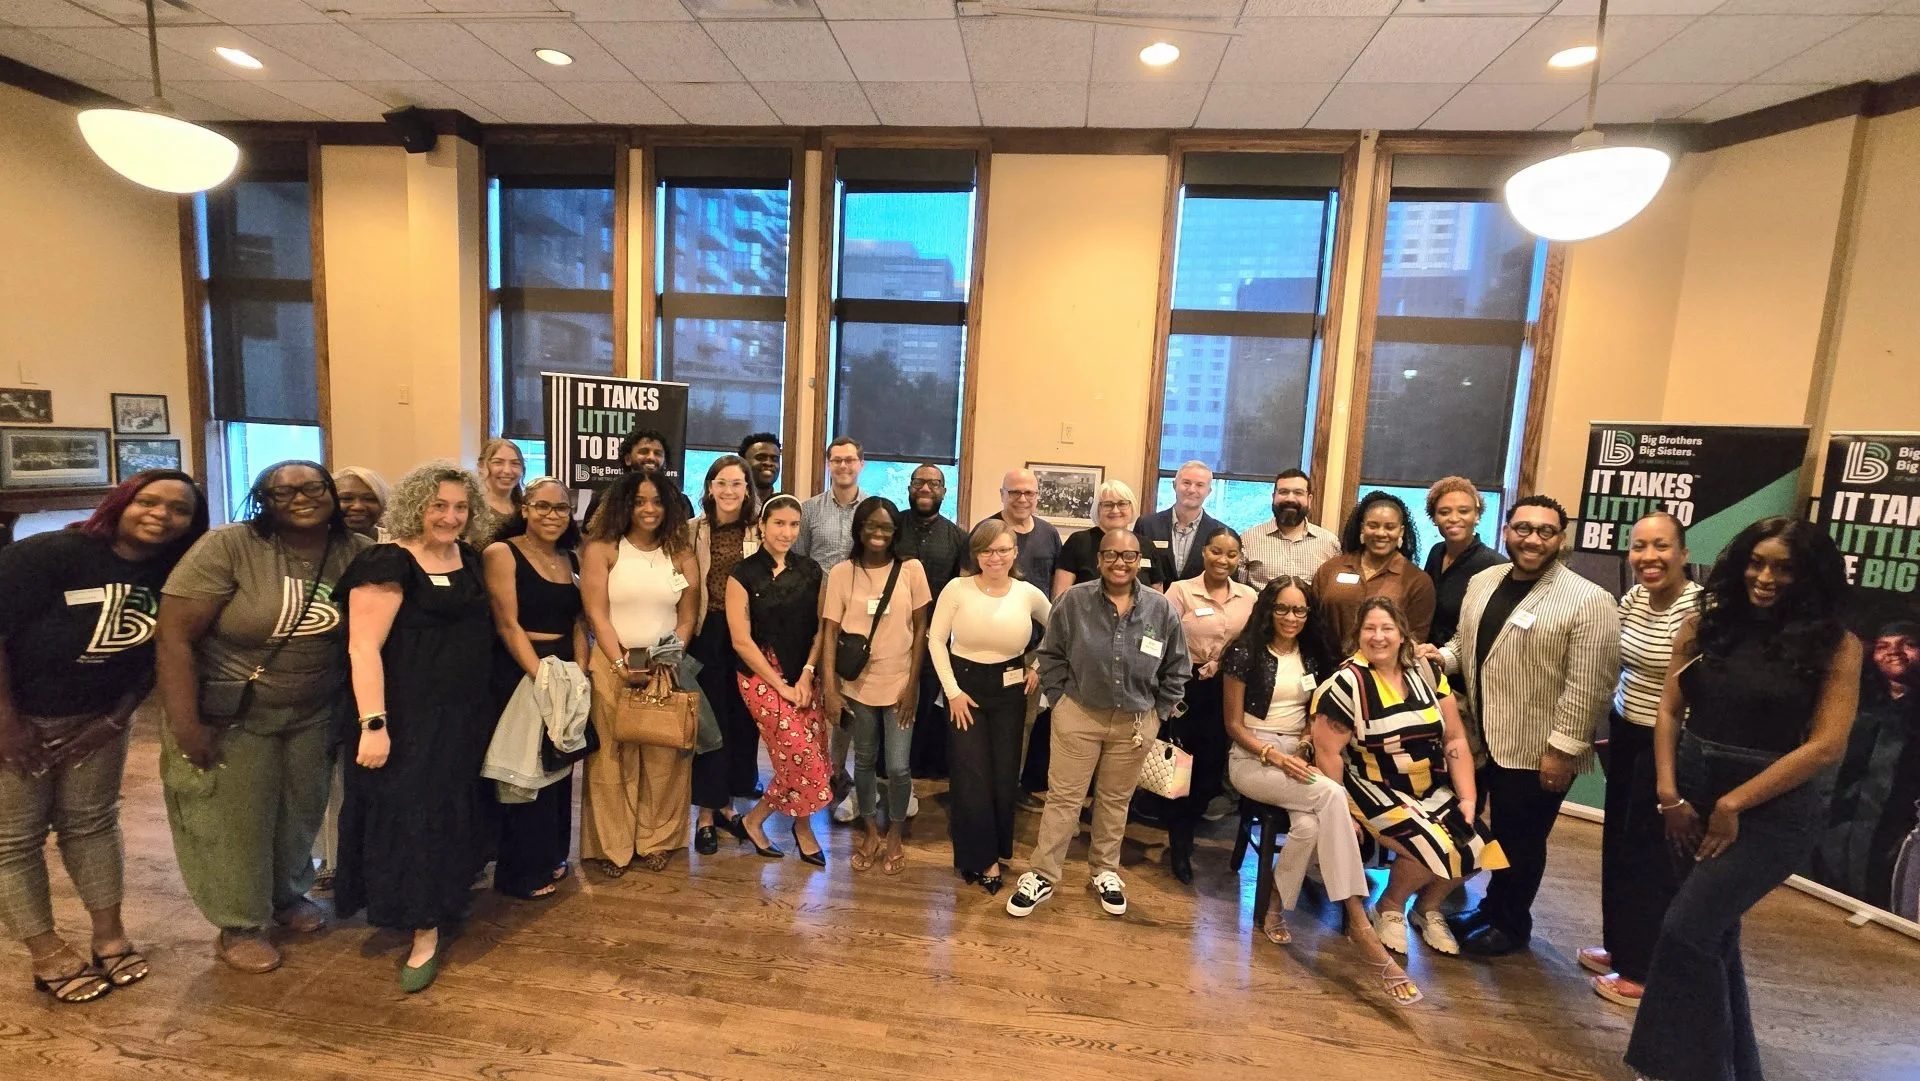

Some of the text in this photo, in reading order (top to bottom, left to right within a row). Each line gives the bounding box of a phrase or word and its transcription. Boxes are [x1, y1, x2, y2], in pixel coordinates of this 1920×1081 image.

[577, 382, 660, 411] IT TAKES
[577, 409, 636, 434] LITTLE
[577, 435, 625, 460] TO B
[1640, 446, 1657, 458] Big
[1641, 434, 1703, 447] Big Brothers
[1898, 446, 1920, 461] Big
[591, 465, 605, 477] Big
[1896, 460, 1920, 474] Big
[1590, 469, 1616, 495] IT
[1665, 500, 1695, 527] TO
[1831, 491, 1865, 522] IT
[1582, 521, 1615, 551] BE
[1843, 554, 1919, 593] E BIG
